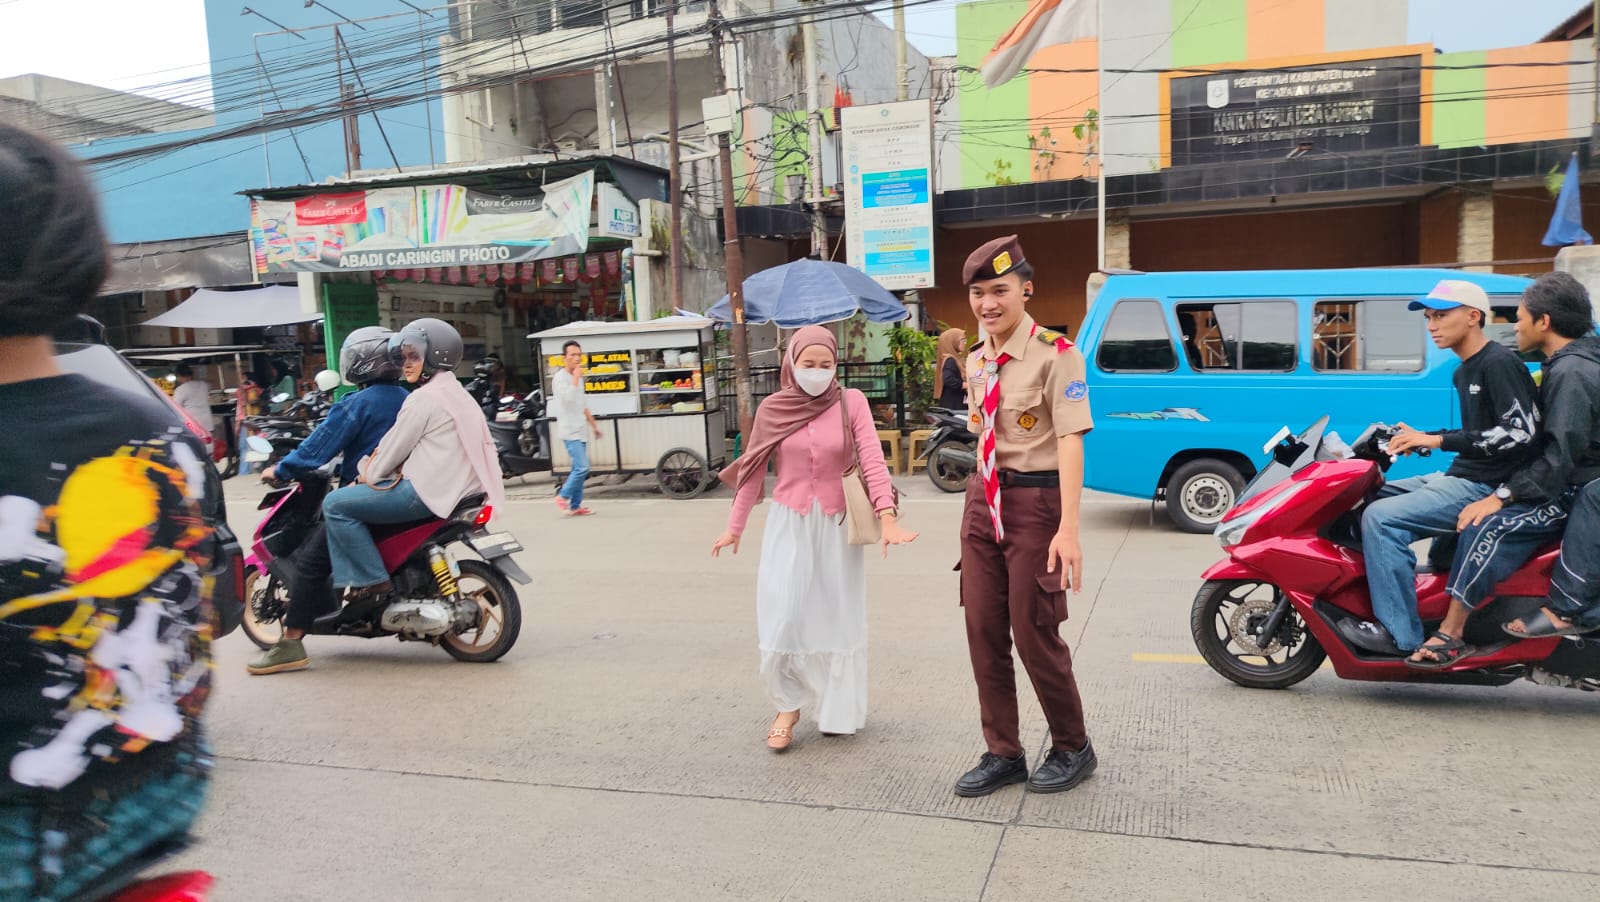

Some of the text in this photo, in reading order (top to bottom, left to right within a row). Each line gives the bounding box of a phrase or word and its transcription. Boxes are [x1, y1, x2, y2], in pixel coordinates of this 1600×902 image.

[339, 246, 510, 269] ABADI CARINGIN PHOTO
